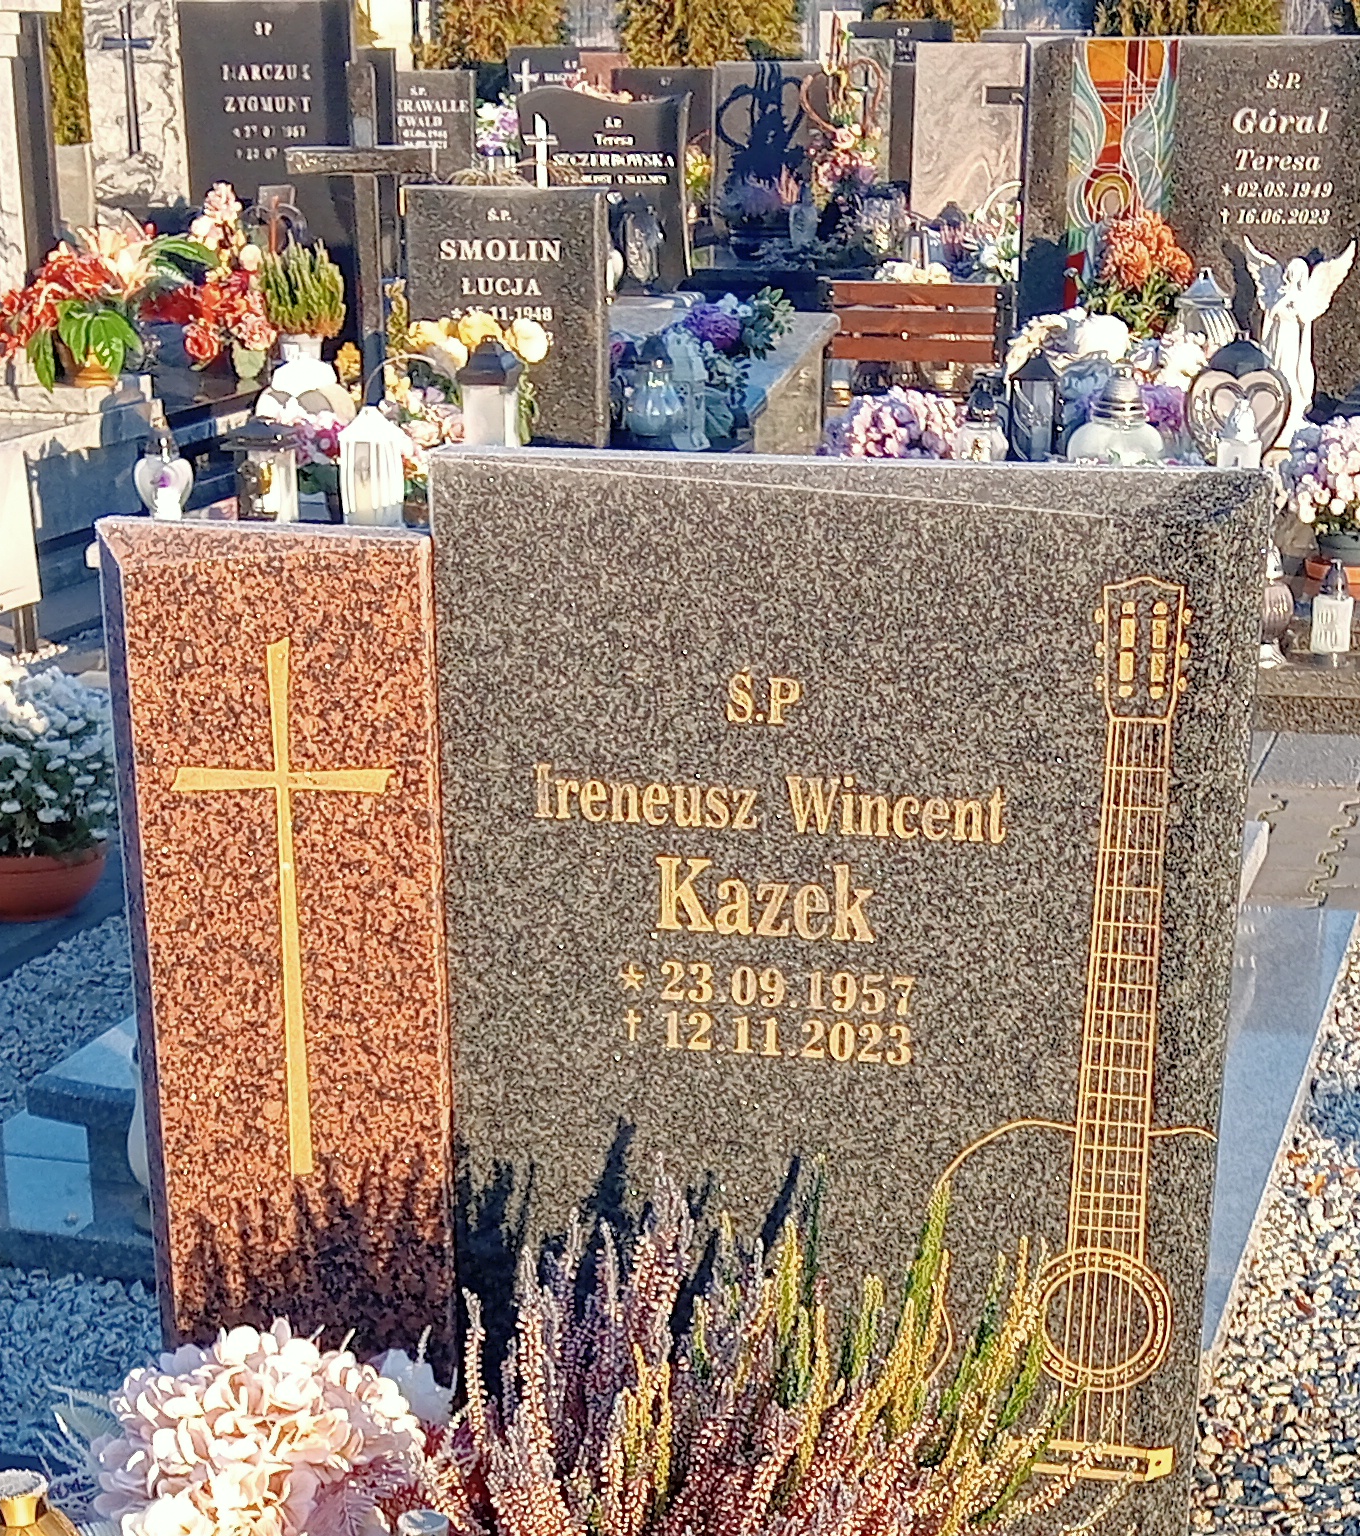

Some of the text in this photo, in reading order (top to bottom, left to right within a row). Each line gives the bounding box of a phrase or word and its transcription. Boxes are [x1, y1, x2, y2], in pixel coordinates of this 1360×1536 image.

[1266, 69, 1302, 89] Ś.P.
[224, 96, 311, 112] ZYGMUNT
[1232, 107, 1329, 134] Góral
[1235, 149, 1321, 171] Teresa
[1237, 181, 1334, 198] 02.08.1949
[1237, 208, 1332, 225] 16.06.2023
[440, 239, 561, 262] SMOLIN
[461, 277, 542, 296] ŁUCJA
[533, 762, 1008, 844] Ireneusz Wincent
[655, 854, 877, 943] Kazek
[661, 1010, 915, 1066] 12.11.2023
